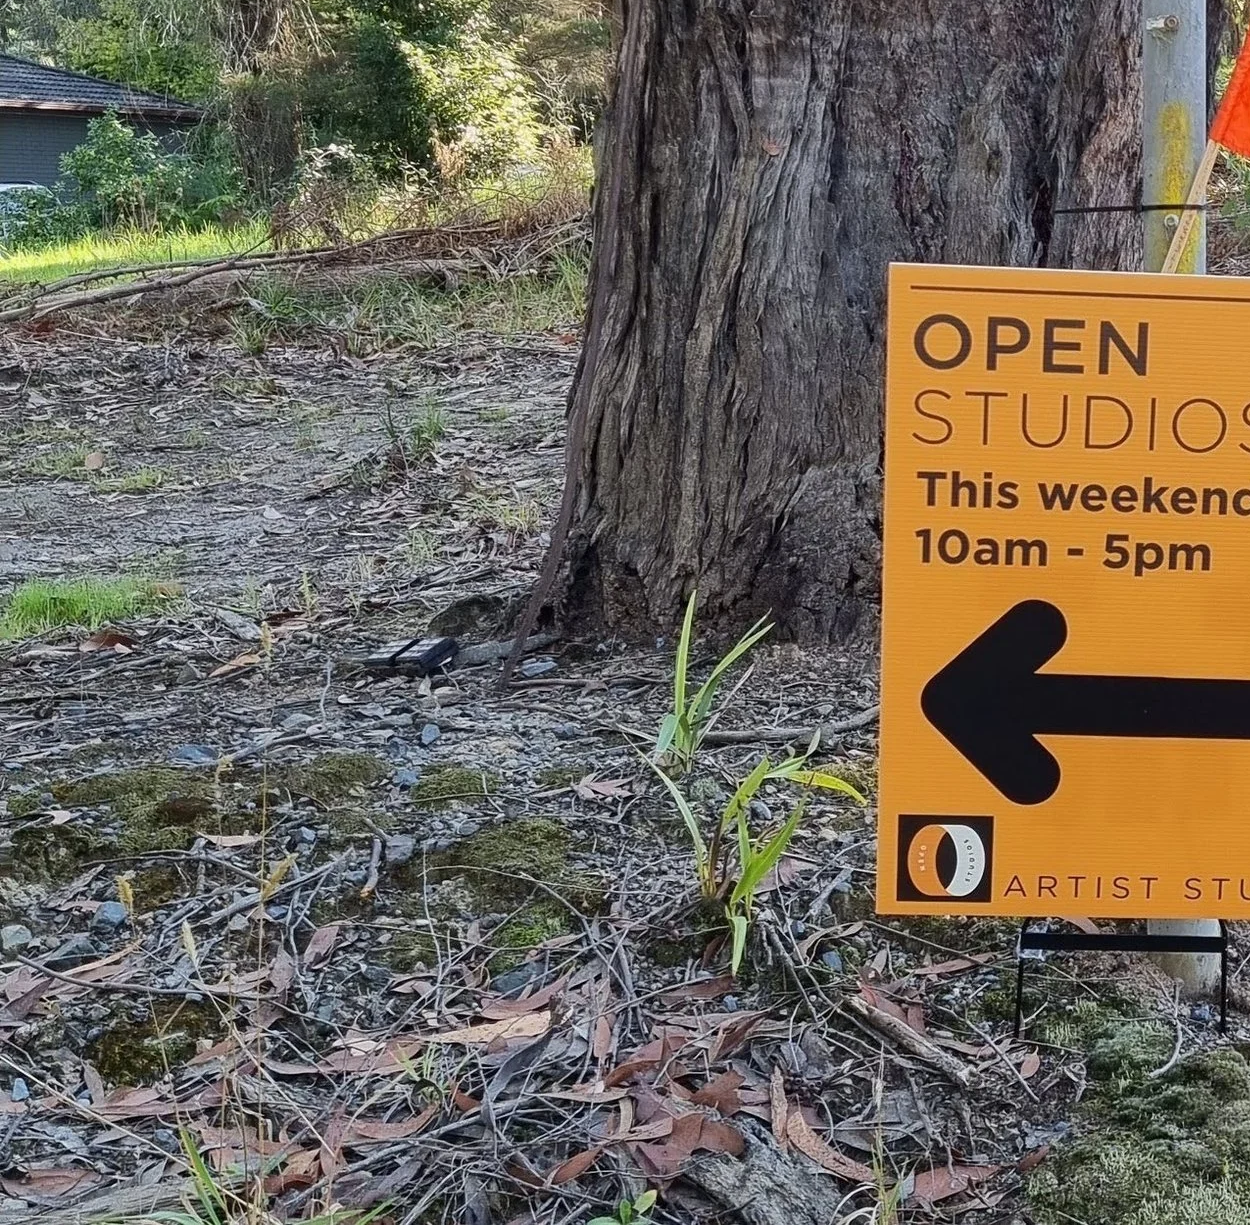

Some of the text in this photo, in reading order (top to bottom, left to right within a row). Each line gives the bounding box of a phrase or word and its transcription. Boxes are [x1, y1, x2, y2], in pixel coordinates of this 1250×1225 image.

[913, 313, 1149, 376] OPEN
[917, 470, 1019, 510] This
[915, 528, 1048, 567] 10am
[1102, 533, 1211, 577] 5pm
[1003, 875, 1159, 900] ARTIST
